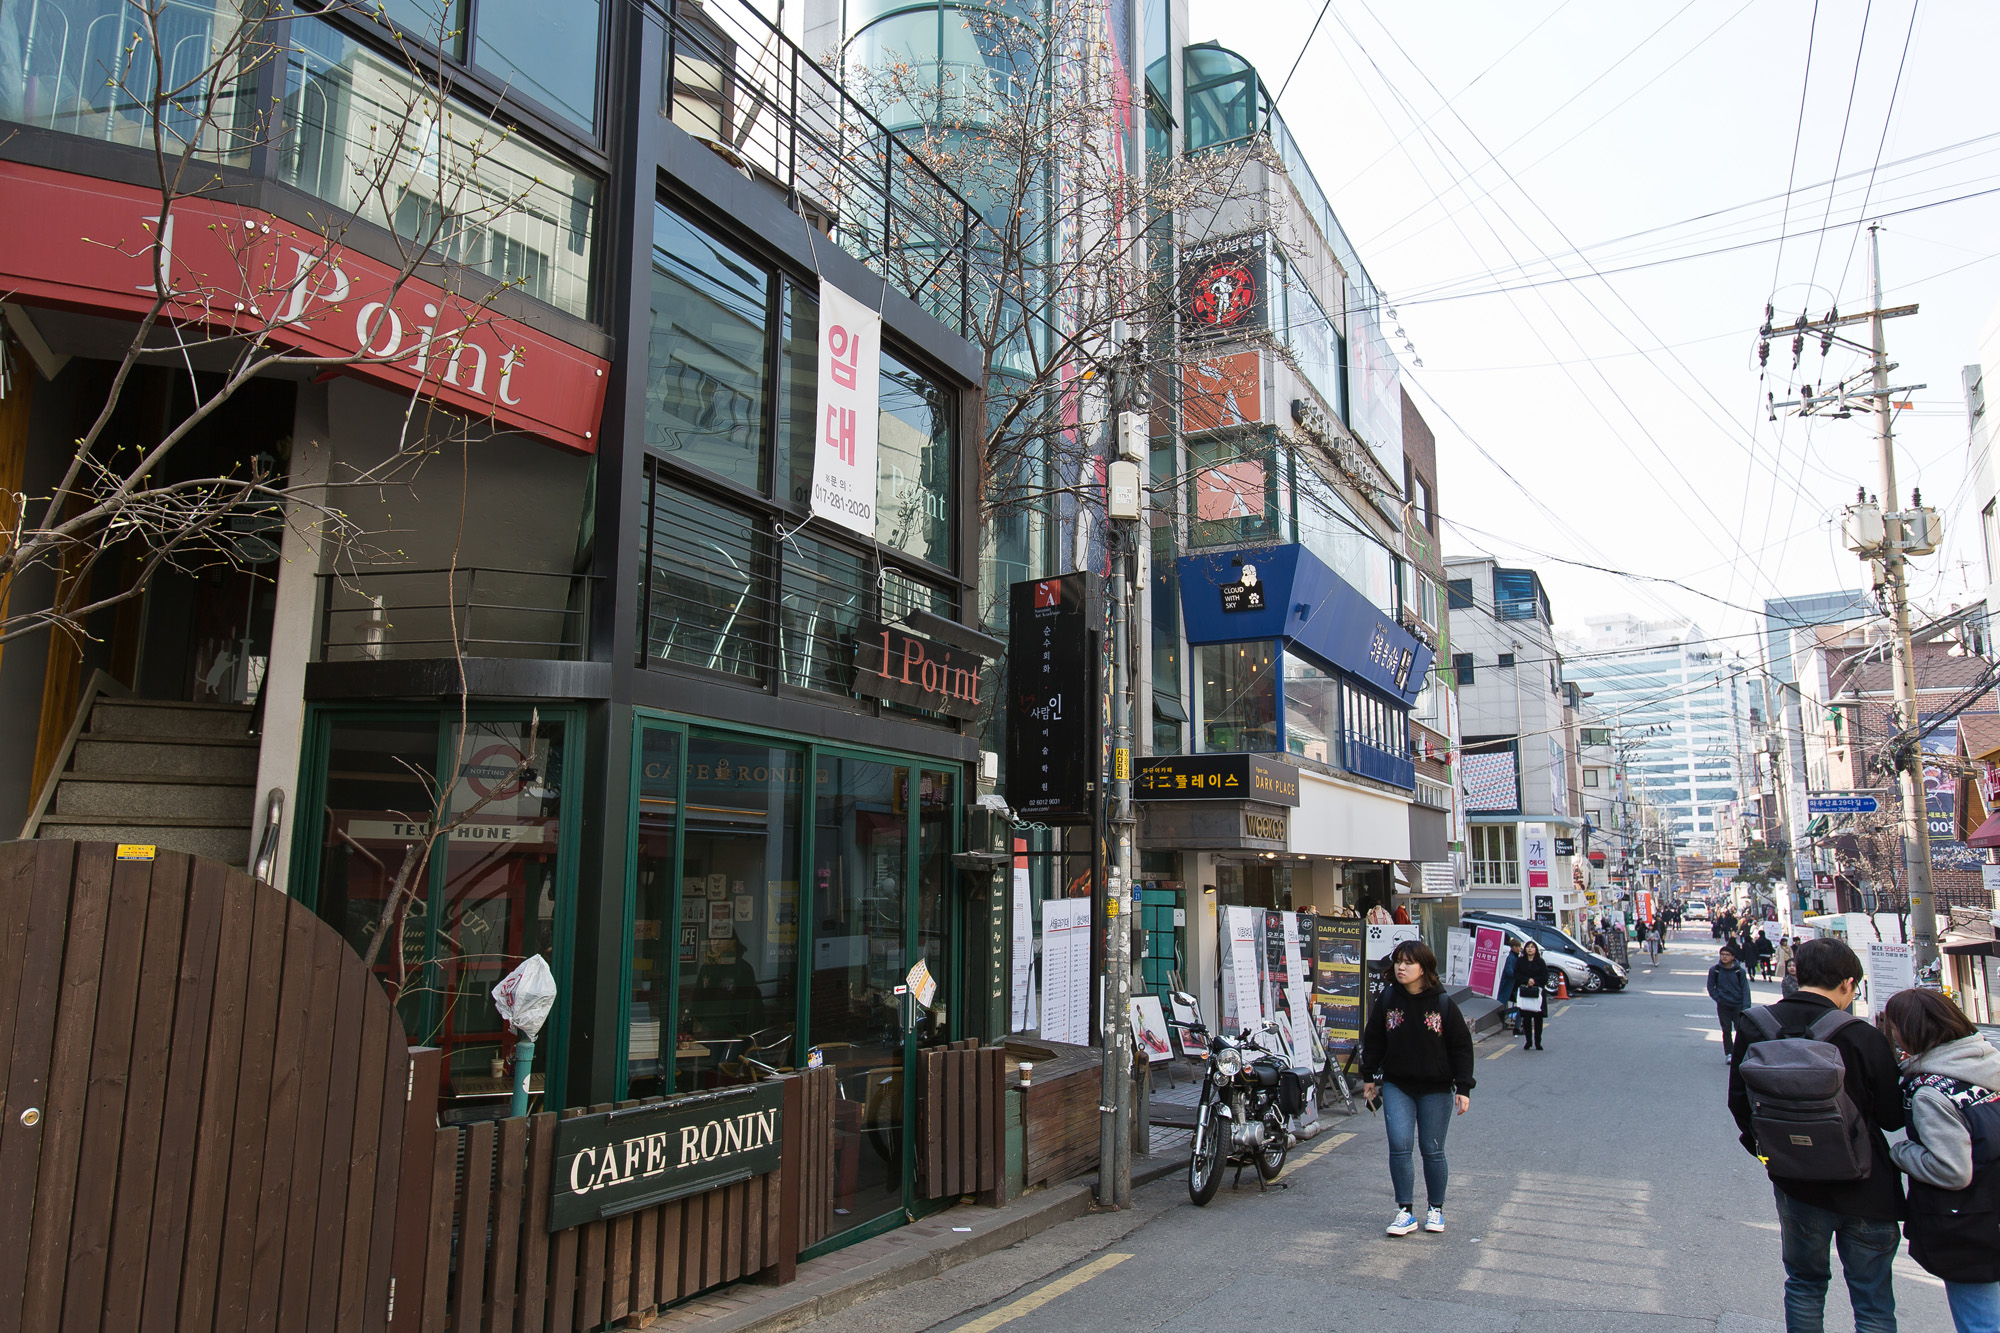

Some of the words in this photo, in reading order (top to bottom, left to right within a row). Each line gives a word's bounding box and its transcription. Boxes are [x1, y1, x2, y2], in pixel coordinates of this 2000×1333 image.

[276, 245, 527, 407] Point
[815, 483, 871, 520] 017-281-2020
[1223, 586, 1245, 594] CLOUD
[878, 630, 893, 679] 1
[900, 636, 983, 705] Point
[470, 768, 505, 776] NOTTING
[1255, 775, 1273, 791] DARK
[1275, 780, 1295, 796] PLACE
[1528, 859, 1546, 867] 헤어
[1318, 925, 1337, 933] DARK
[1338, 926, 1360, 935] PLACE
[569, 1131, 667, 1195] CAFE
[677, 1107, 777, 1168] RONIN
